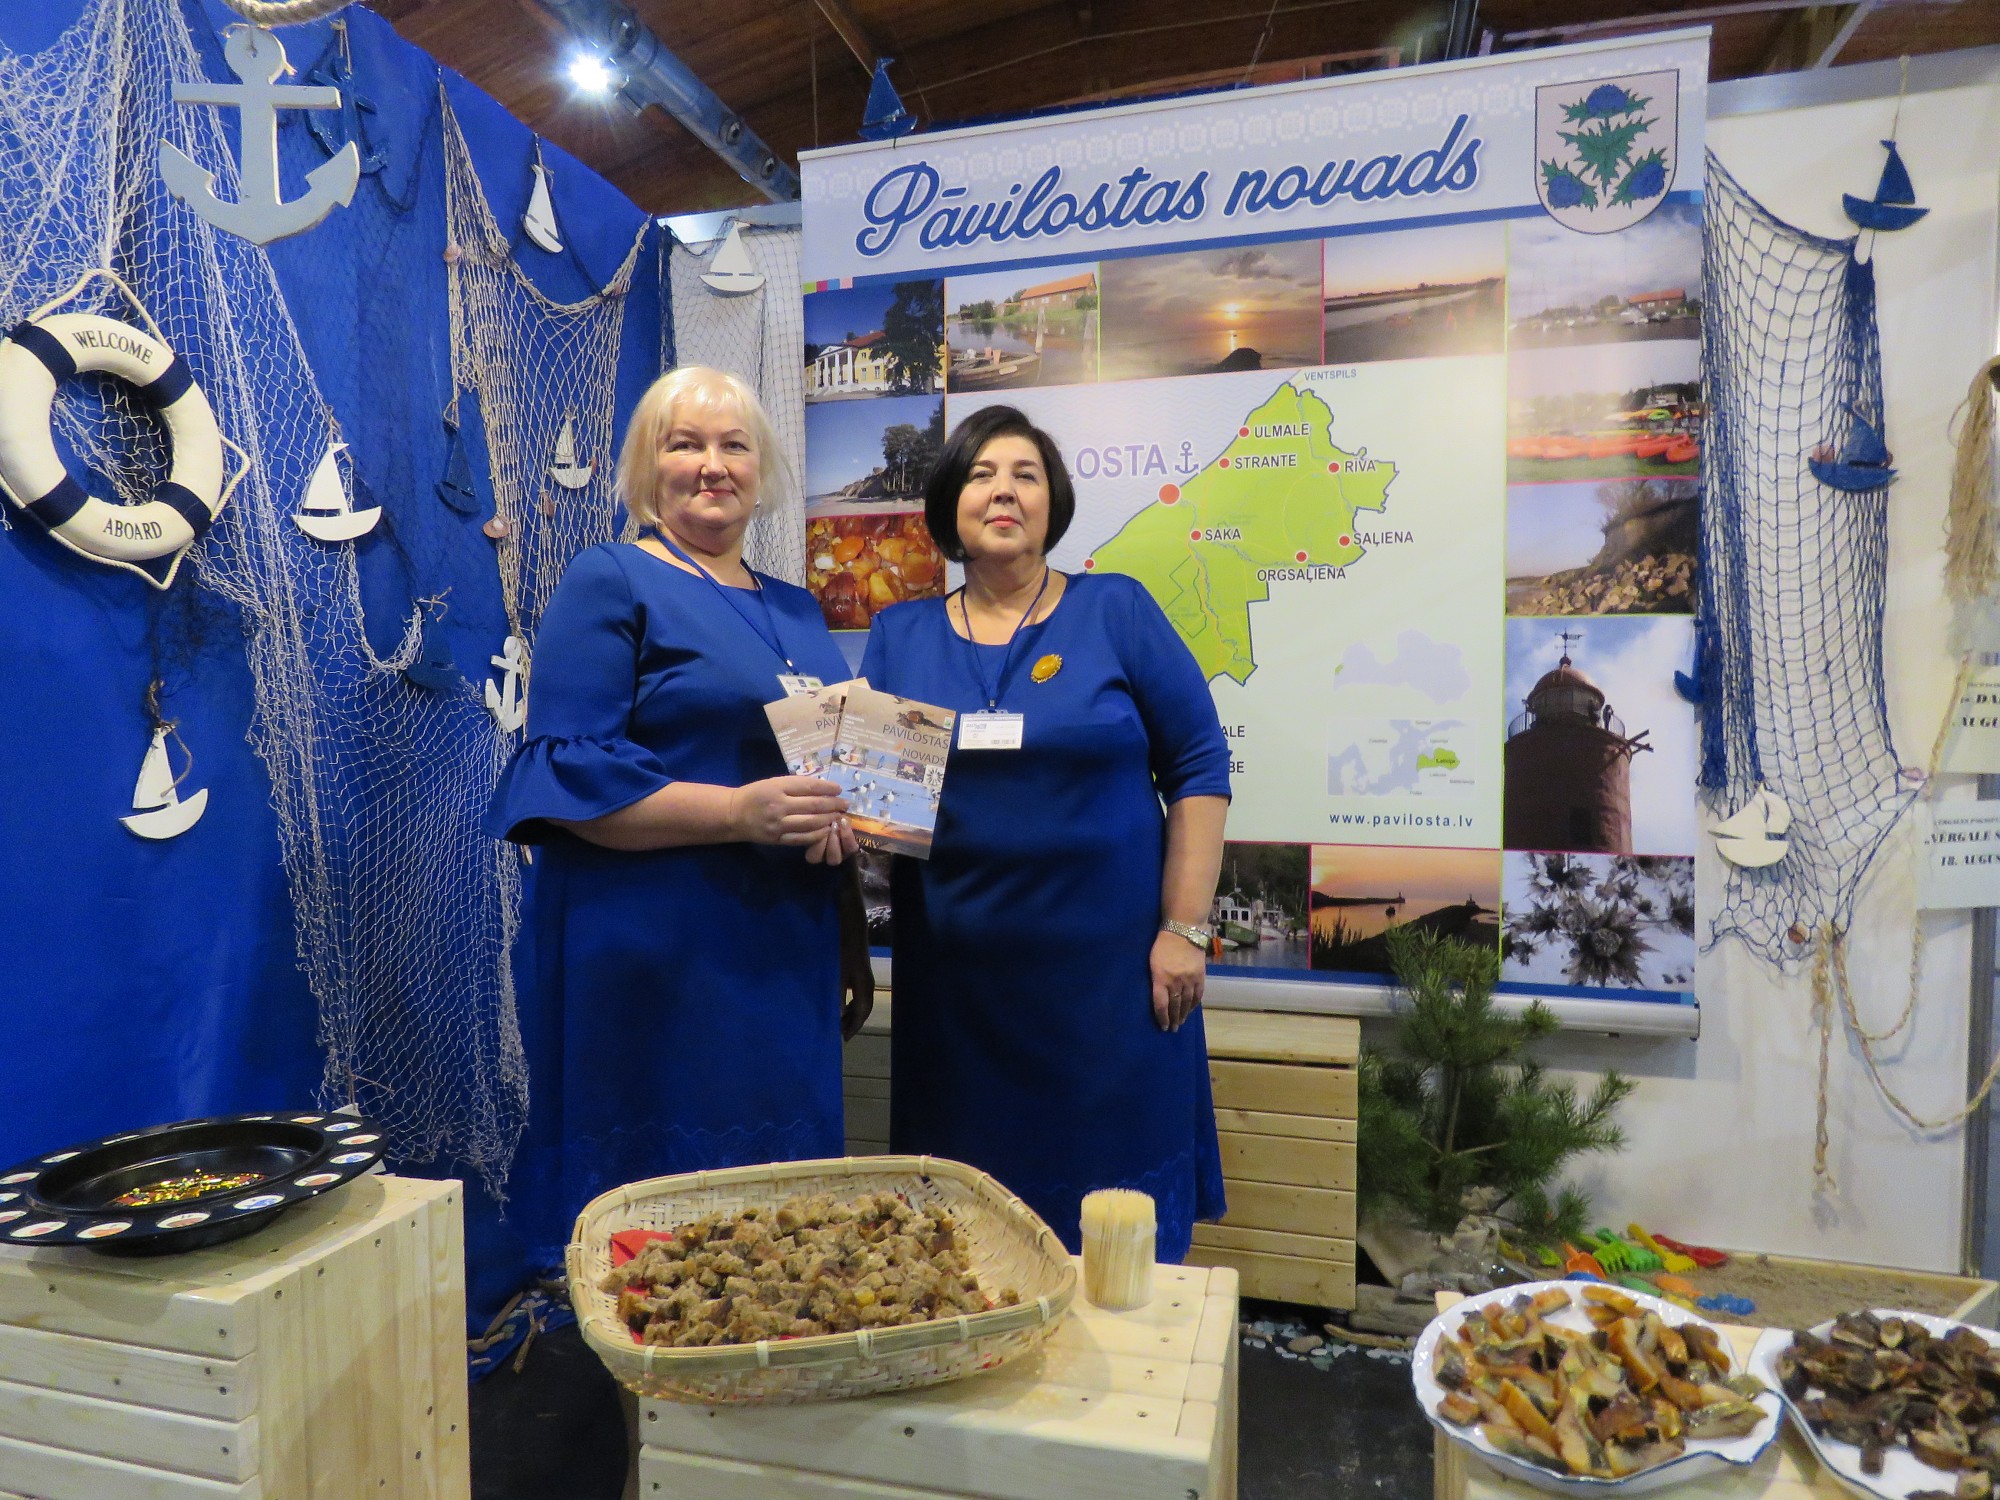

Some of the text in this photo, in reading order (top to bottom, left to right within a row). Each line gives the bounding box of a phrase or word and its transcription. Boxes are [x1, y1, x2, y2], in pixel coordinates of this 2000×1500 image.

[855, 113, 1485, 257] Pāvilostas novads
[72, 330, 153, 365] WELCOME
[1304, 369, 1357, 382] VENTSPILS
[1254, 423, 1310, 438] ULMALE
[1234, 454, 1297, 469] STRANTE
[103, 517, 163, 540] ABOARD
[1205, 528, 1241, 541] SAKA
[1353, 531, 1414, 547] SAĻIENA
[902, 748, 946, 766] NOVADS
[1329, 812, 1473, 828] www.pavilosta.lv
